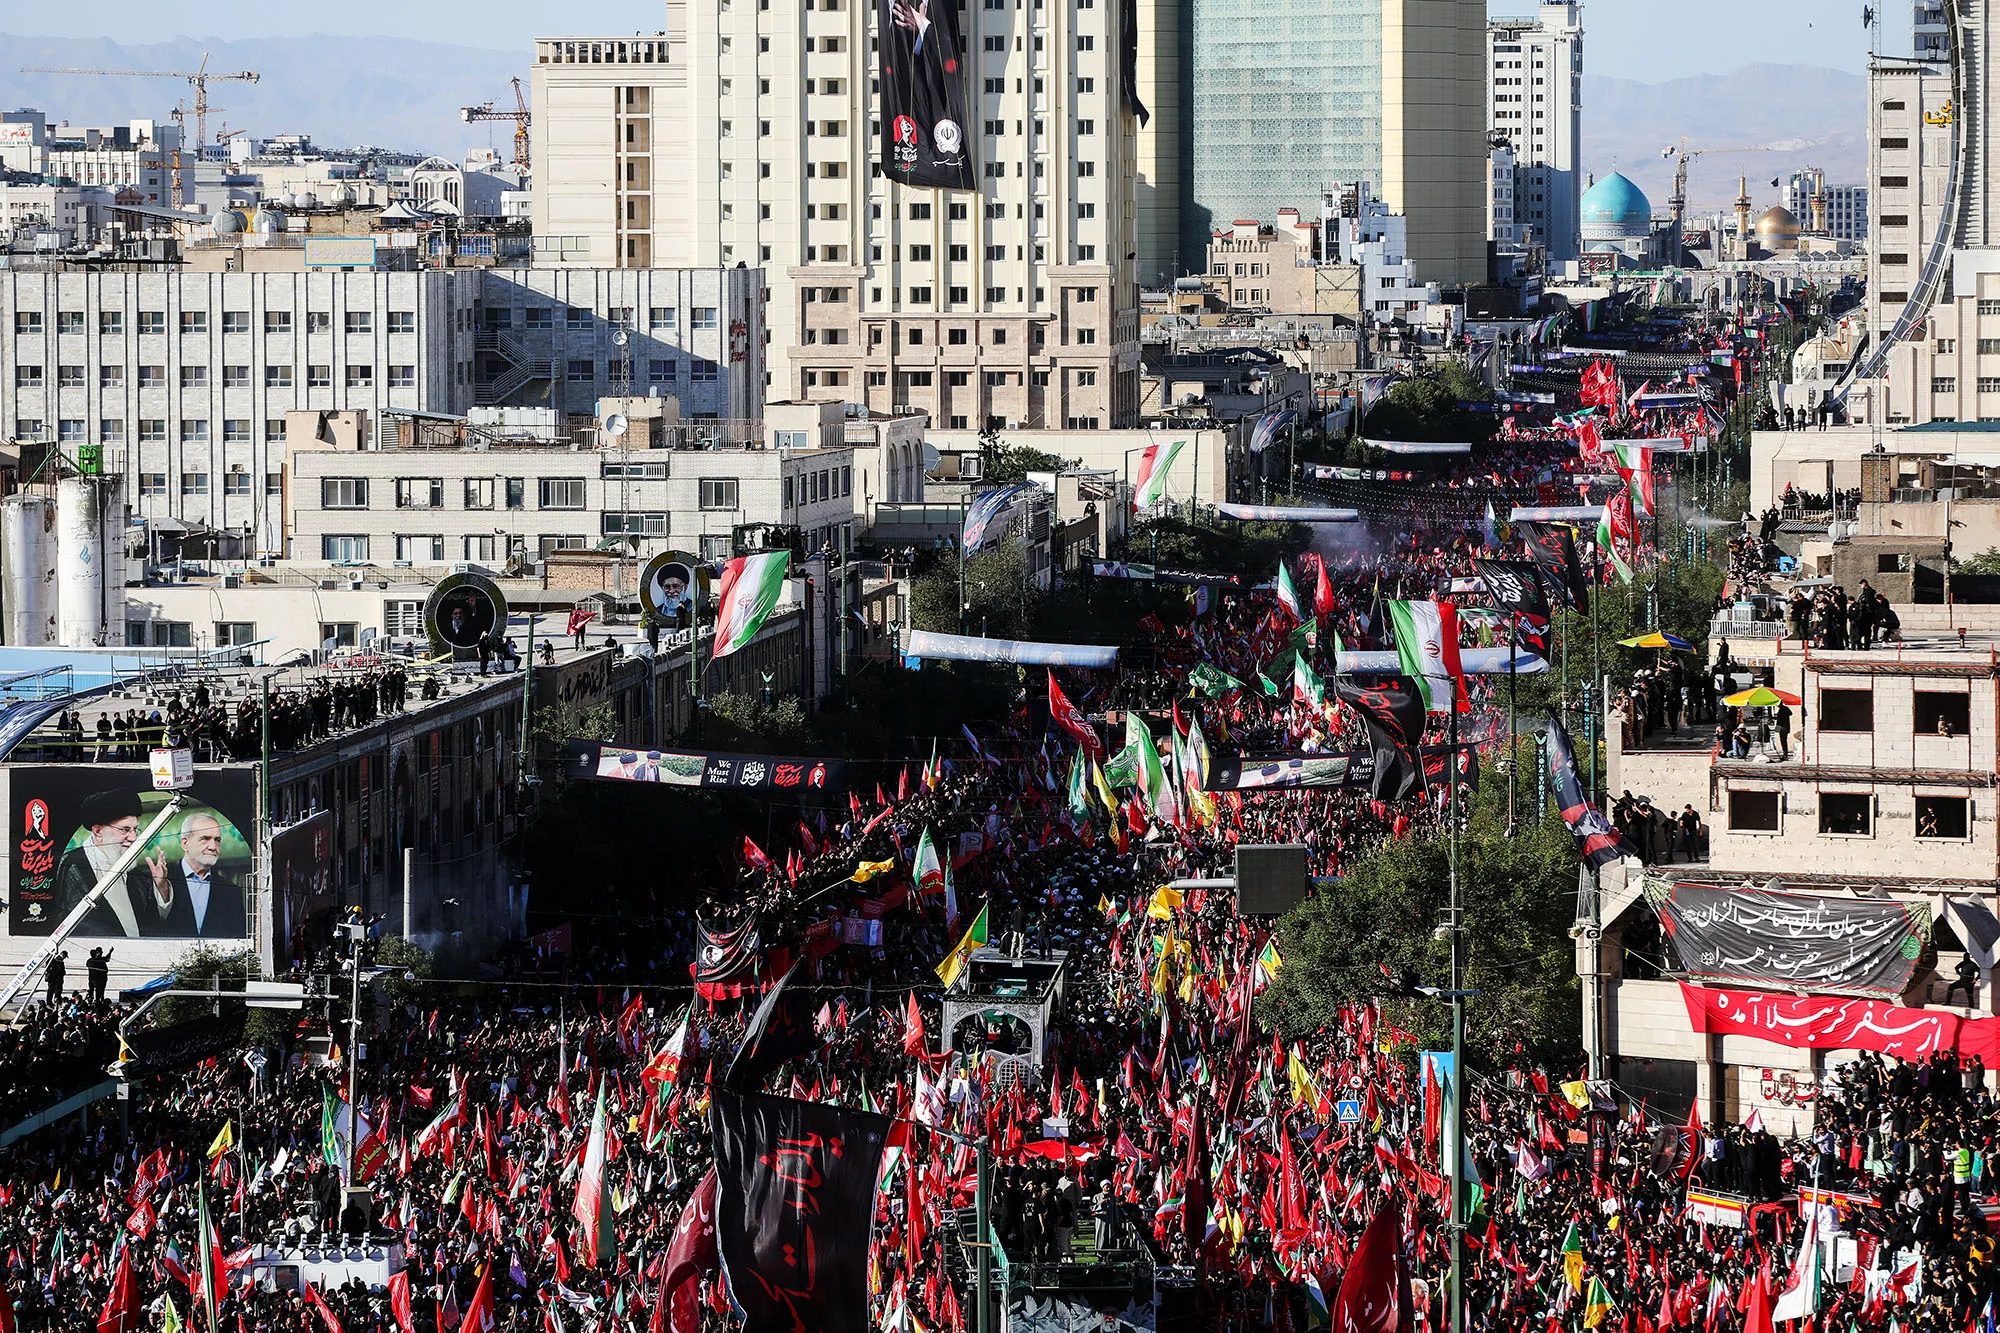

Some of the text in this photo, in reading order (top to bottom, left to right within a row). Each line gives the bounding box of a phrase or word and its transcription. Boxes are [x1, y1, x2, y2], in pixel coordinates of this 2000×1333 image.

[718, 759, 731, 769] We
[1360, 757, 1374, 766] We
[707, 768, 729, 777] Must
[1350, 765, 1372, 774] Must
[709, 775, 727, 785] Rise
[1352, 773, 1370, 781] Rise
[1696, 897, 1738, 927] الزمان
[1715, 945, 1774, 969] زهرا
[1775, 943, 1821, 976] حضرت
[26, 960, 38, 972] CTE
[1717, 992, 1942, 1052] از سفر کربلا آمده
